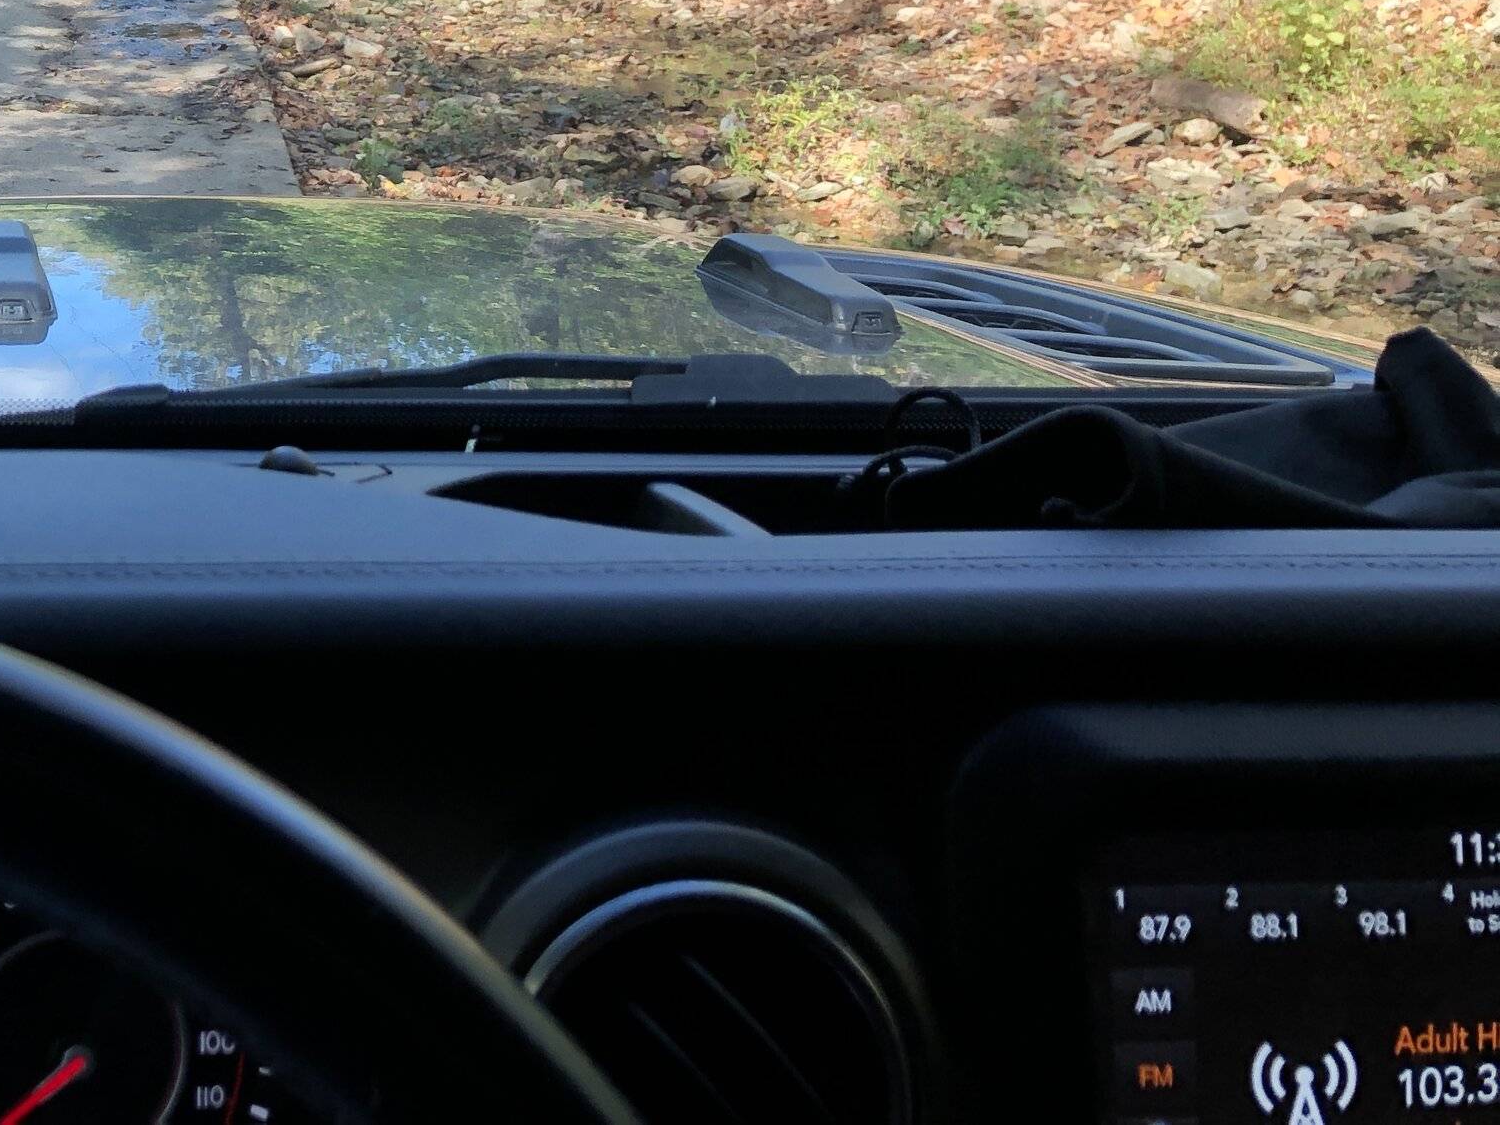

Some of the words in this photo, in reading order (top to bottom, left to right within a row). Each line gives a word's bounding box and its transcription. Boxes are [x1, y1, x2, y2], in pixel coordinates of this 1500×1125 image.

[1450, 831, 1500, 865] 11:
[1115, 888, 1125, 910] 1
[1225, 886, 1239, 909] 2
[1335, 884, 1349, 907] 3
[1442, 882, 1455, 903] 4
[1470, 889, 1500, 910] Hol
[1139, 914, 1192, 942] 87.9
[1250, 912, 1298, 940] 88.1
[1358, 909, 1407, 936] 98.1
[1488, 914, 1500, 933] S
[1134, 988, 1172, 1013] AM
[1394, 1021, 1469, 1056] Adult
[1477, 1021, 1500, 1052] H
[1138, 1062, 1174, 1088] FM
[1398, 1062, 1499, 1109] 103.3
[196, 1084, 225, 1109] 110
